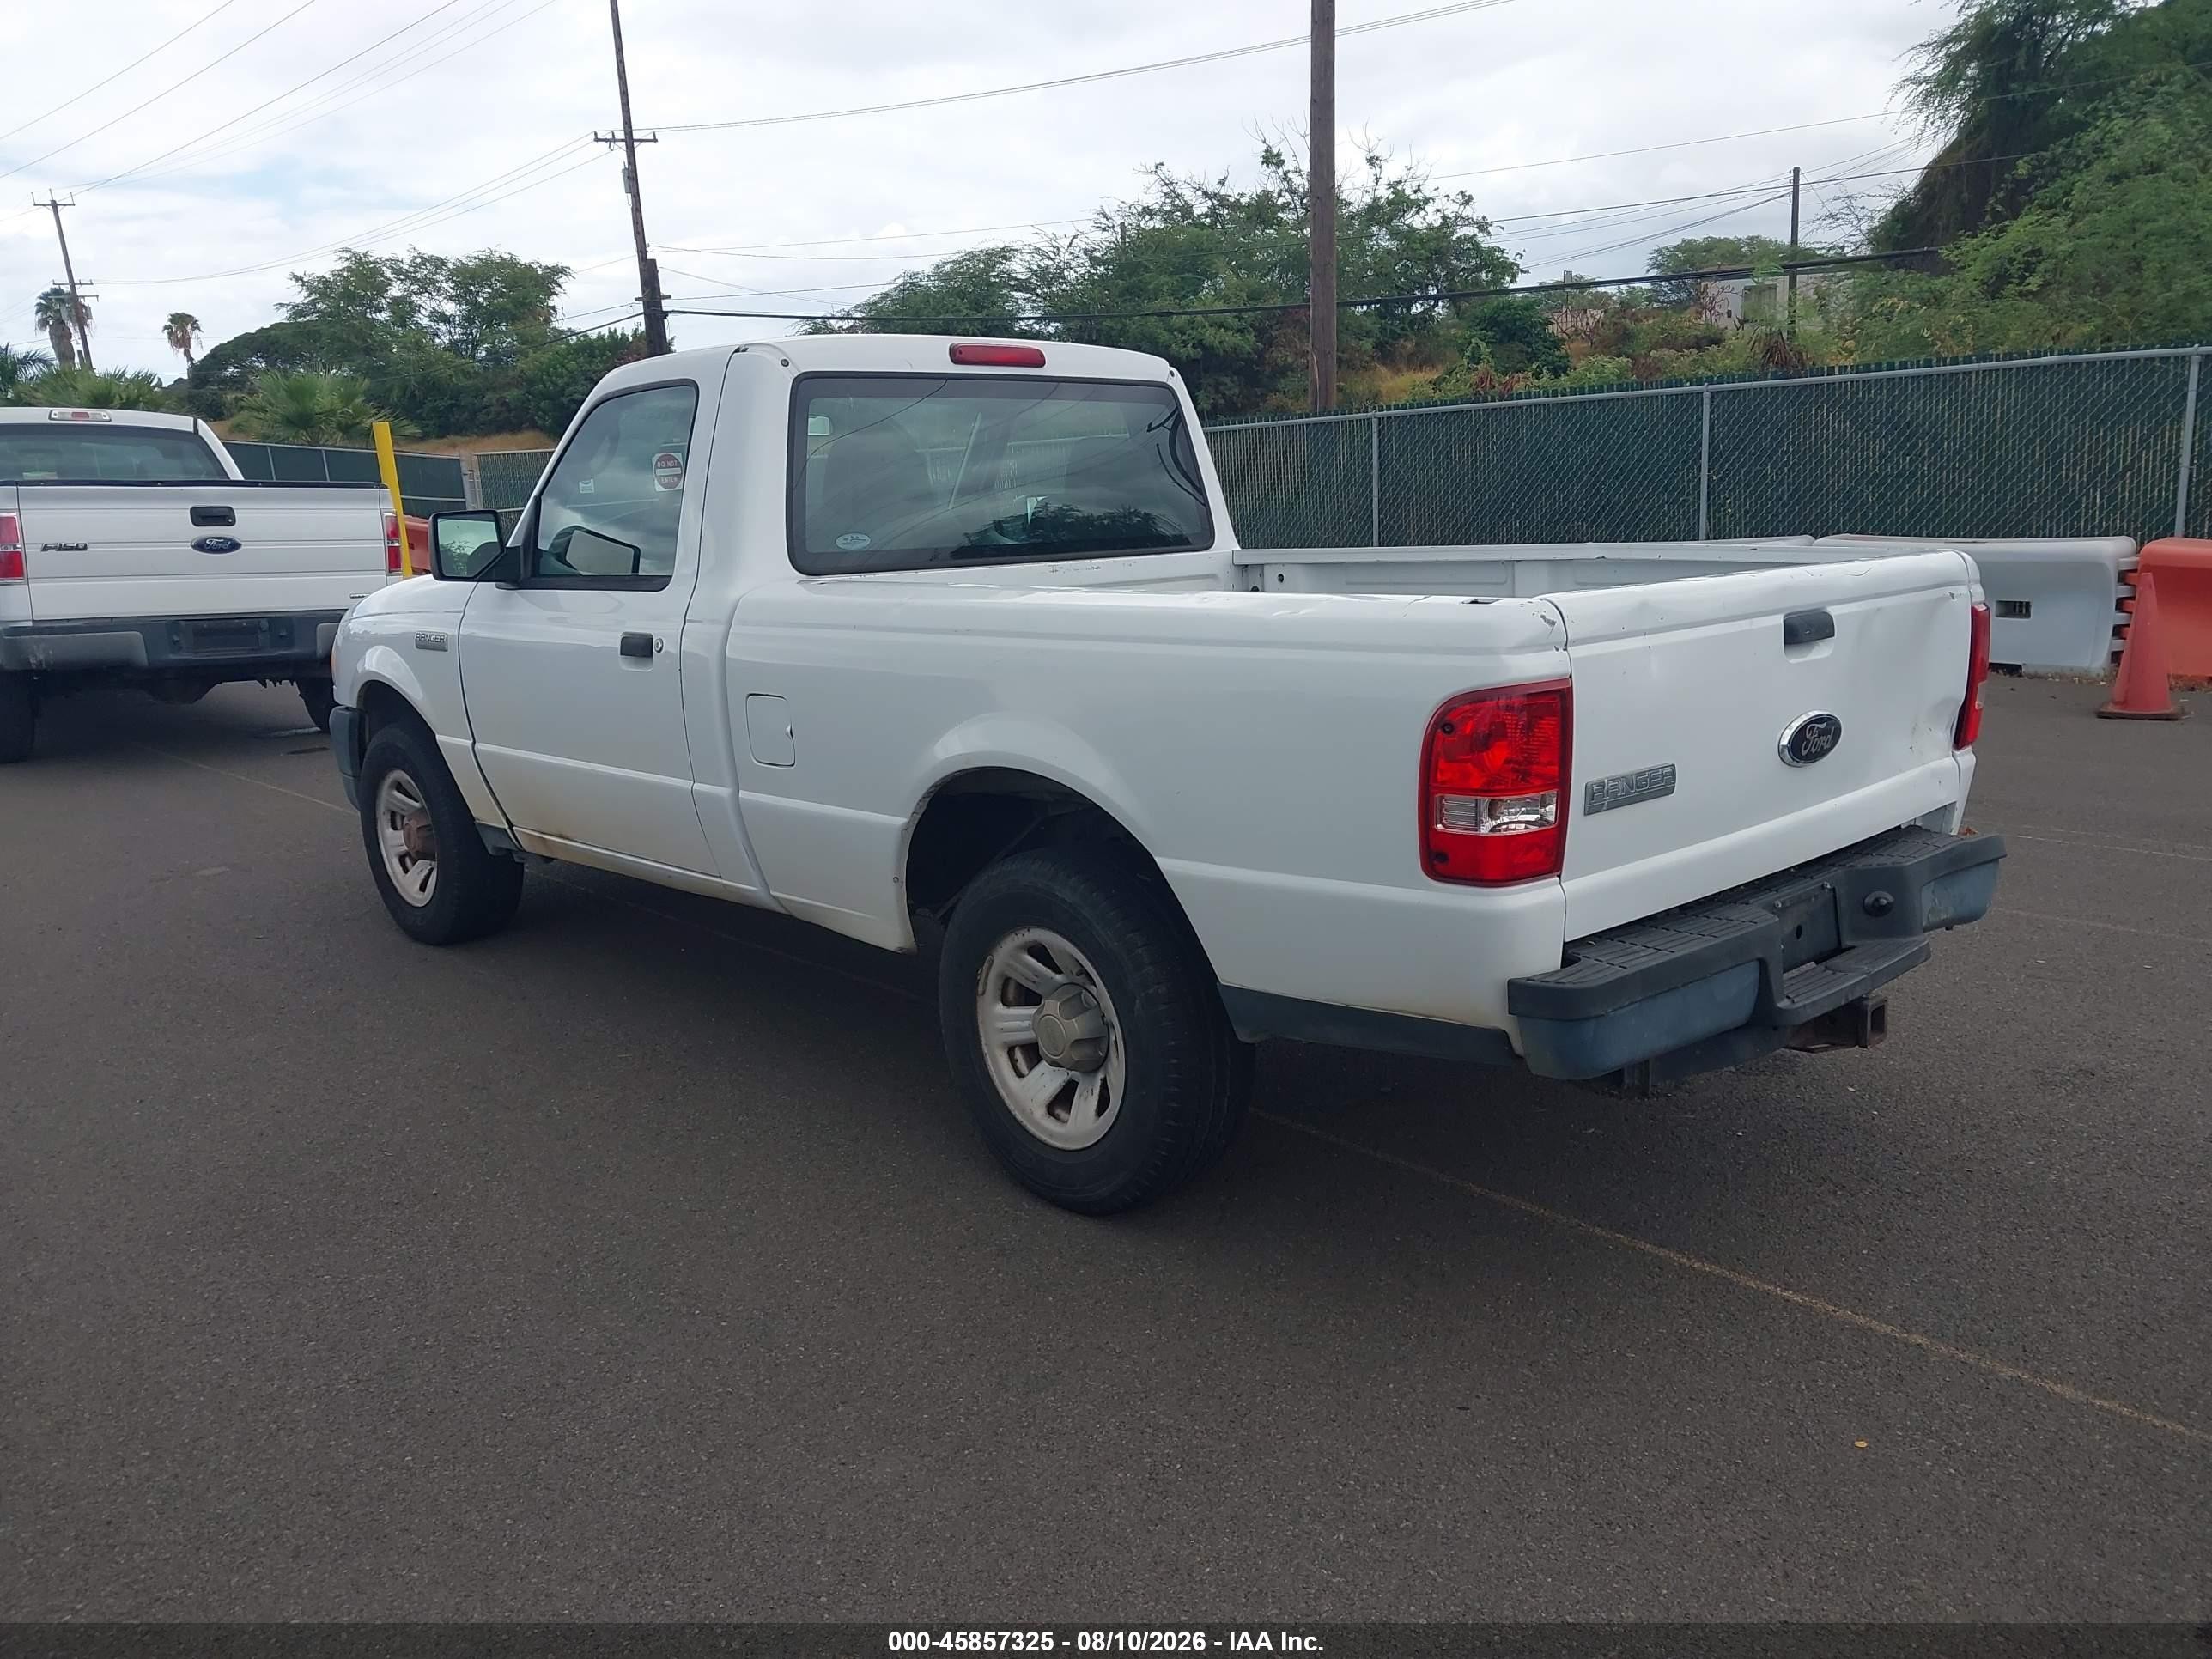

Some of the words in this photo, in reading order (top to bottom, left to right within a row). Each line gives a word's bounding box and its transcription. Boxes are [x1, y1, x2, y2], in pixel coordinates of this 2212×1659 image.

[666, 459, 678, 468] NOT
[205, 538, 231, 550] Ford
[415, 631, 447, 643] RANGER
[1801, 721, 1836, 757] Ford
[1589, 767, 1676, 804] RANGER
